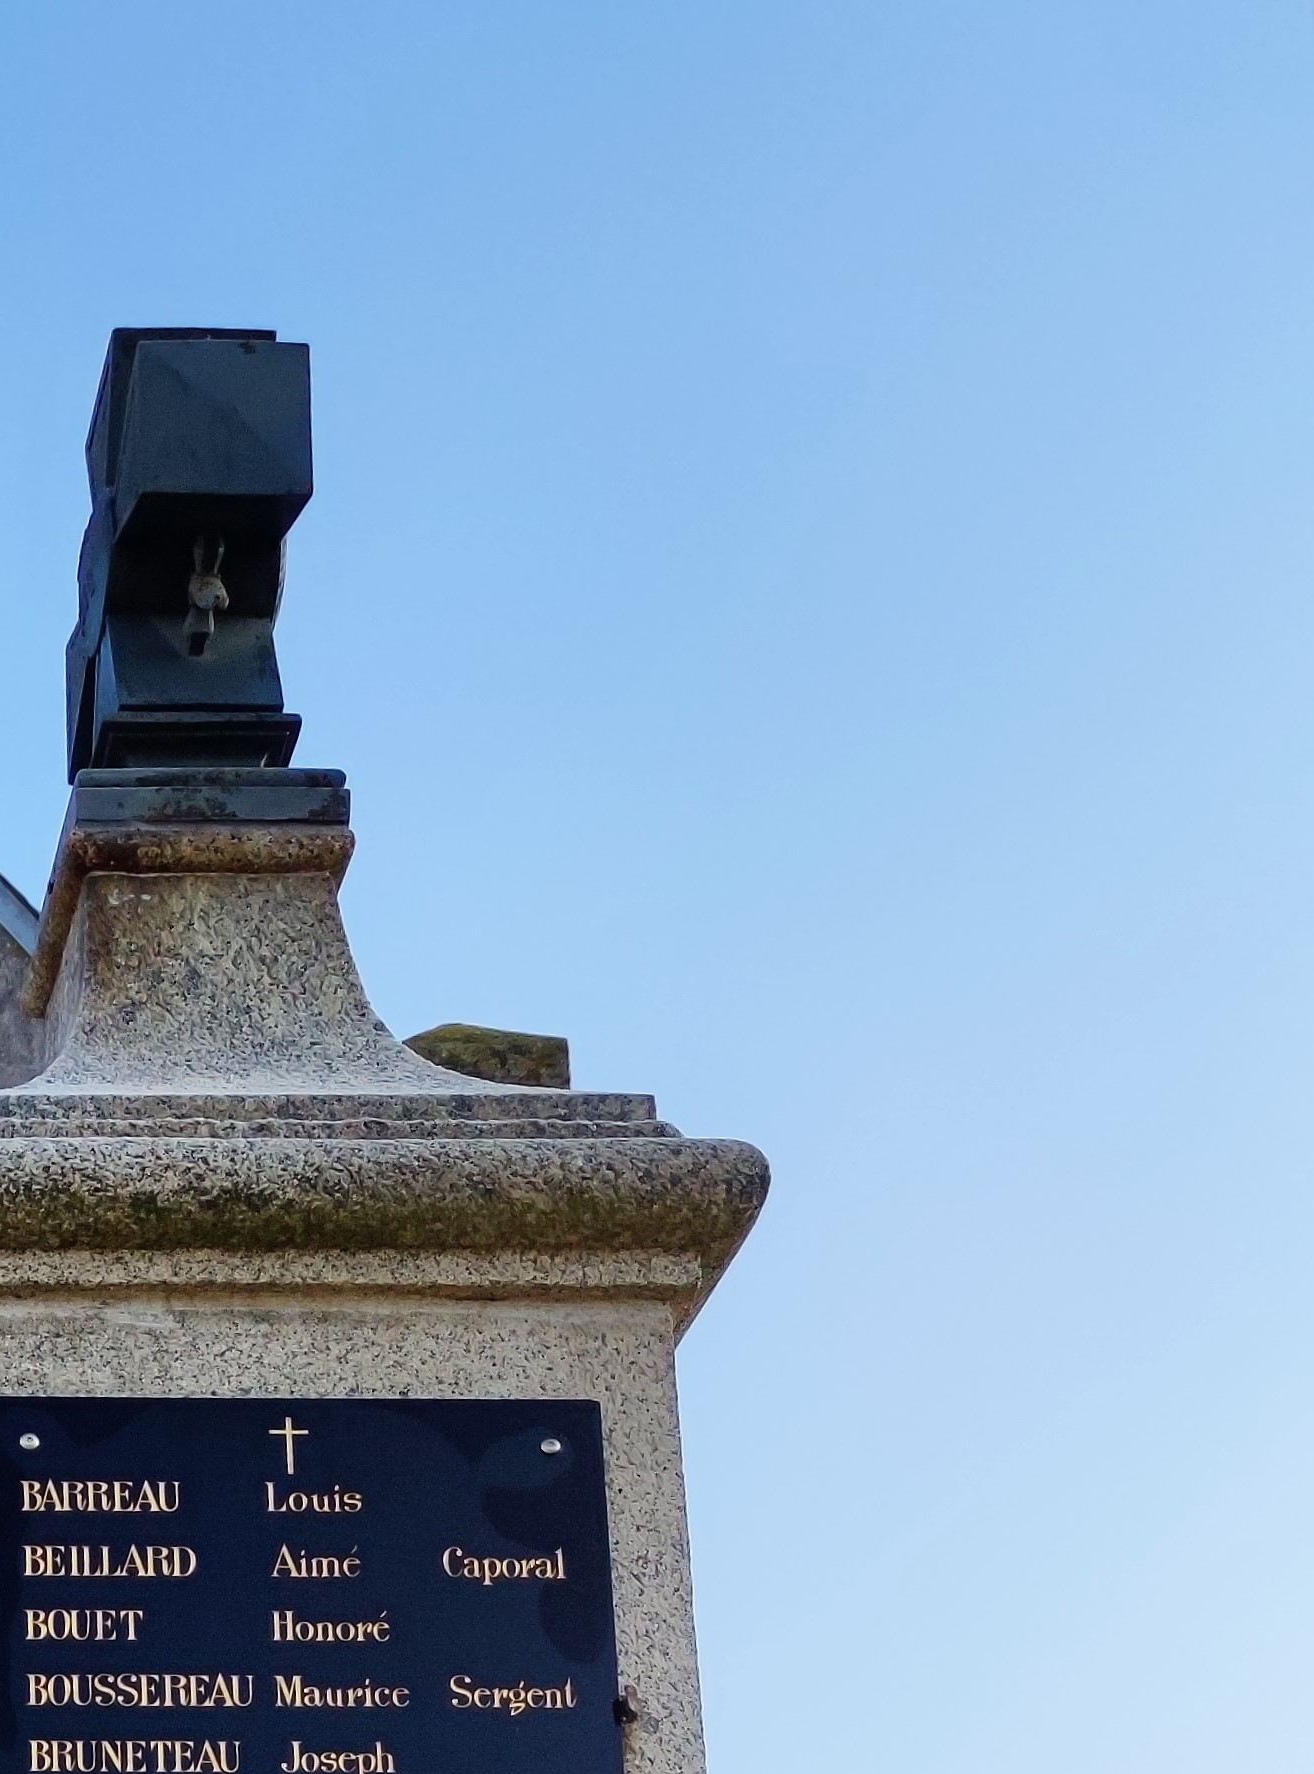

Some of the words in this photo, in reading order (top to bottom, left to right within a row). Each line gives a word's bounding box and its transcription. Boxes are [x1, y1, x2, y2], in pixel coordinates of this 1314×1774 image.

[19, 1478, 181, 1513] BARREAU
[264, 1481, 362, 1513] Louis
[21, 1543, 197, 1577] BEILLARD
[270, 1542, 361, 1578] Aimé
[442, 1546, 567, 1586] Caporal
[24, 1608, 144, 1641] BOUET
[271, 1610, 390, 1642] Honoré
[26, 1672, 254, 1707] BOUSSEREAU
[273, 1674, 410, 1708] Maurice
[449, 1674, 577, 1717] Sergent
[28, 1739, 241, 1774] BRUNETEAU
